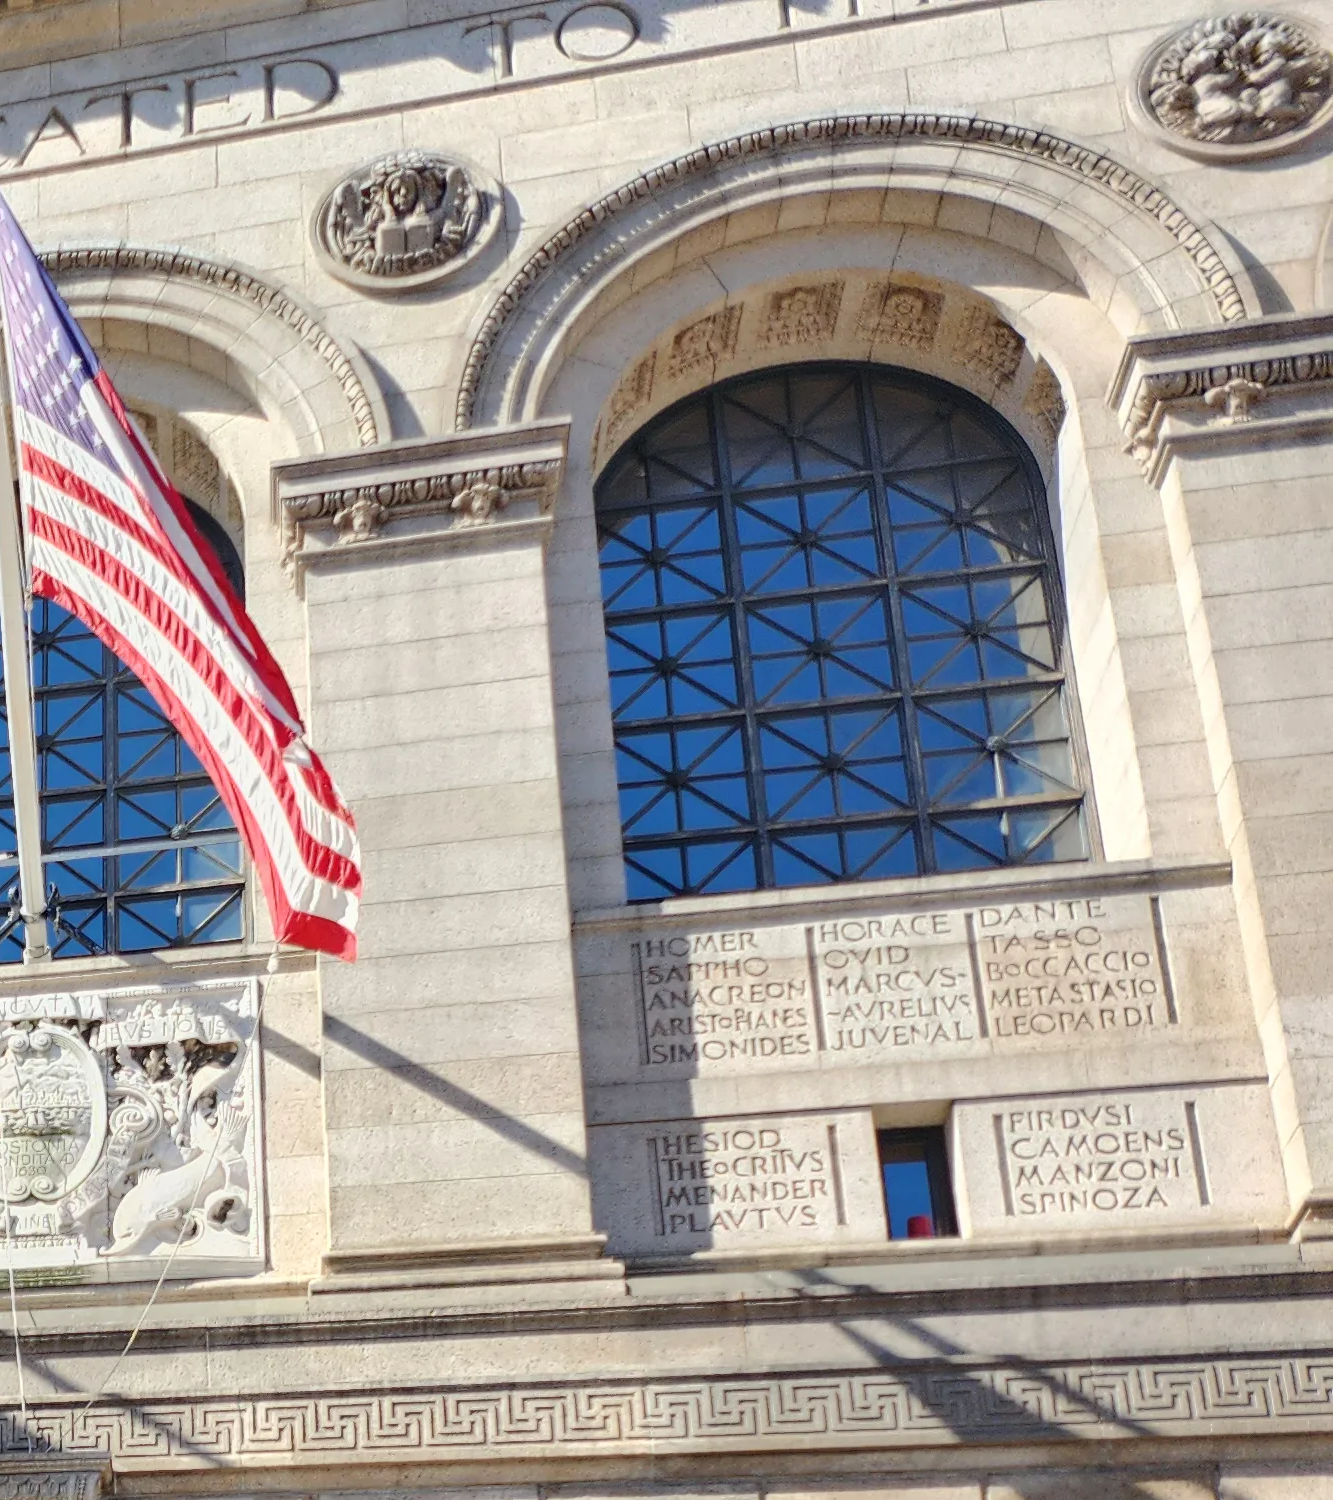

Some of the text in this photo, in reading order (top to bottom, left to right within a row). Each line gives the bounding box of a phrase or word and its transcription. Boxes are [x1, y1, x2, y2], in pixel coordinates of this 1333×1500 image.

[462, 0, 643, 79] TO
[819, 912, 953, 945] HORACE
[979, 897, 1109, 929] DANTE
[645, 929, 759, 960] HOMER
[983, 925, 1103, 955] TASSO
[645, 955, 769, 986] SAPPHO
[822, 944, 911, 970] OVID
[986, 951, 1152, 982] BOCCACCIO
[647, 978, 807, 1013] ANACREON
[990, 978, 1159, 1010] METASTASIO
[829, 1020, 975, 1052] JUVENAL
[995, 1005, 1155, 1038] LEOPARDI
[650, 1032, 812, 1065] SIMONIDES
[1008, 1104, 1137, 1133] FIRDVSI
[662, 1128, 783, 1156] HESIOD
[1009, 1128, 1187, 1161] CAMOENS
[15, 1166, 47, 1177] 1630
[1014, 1156, 1183, 1189] MANZONI
[664, 1177, 829, 1210] MENANDER
[1019, 1185, 1170, 1217] SPINOZA
[668, 1204, 820, 1235] PLAVTVS
